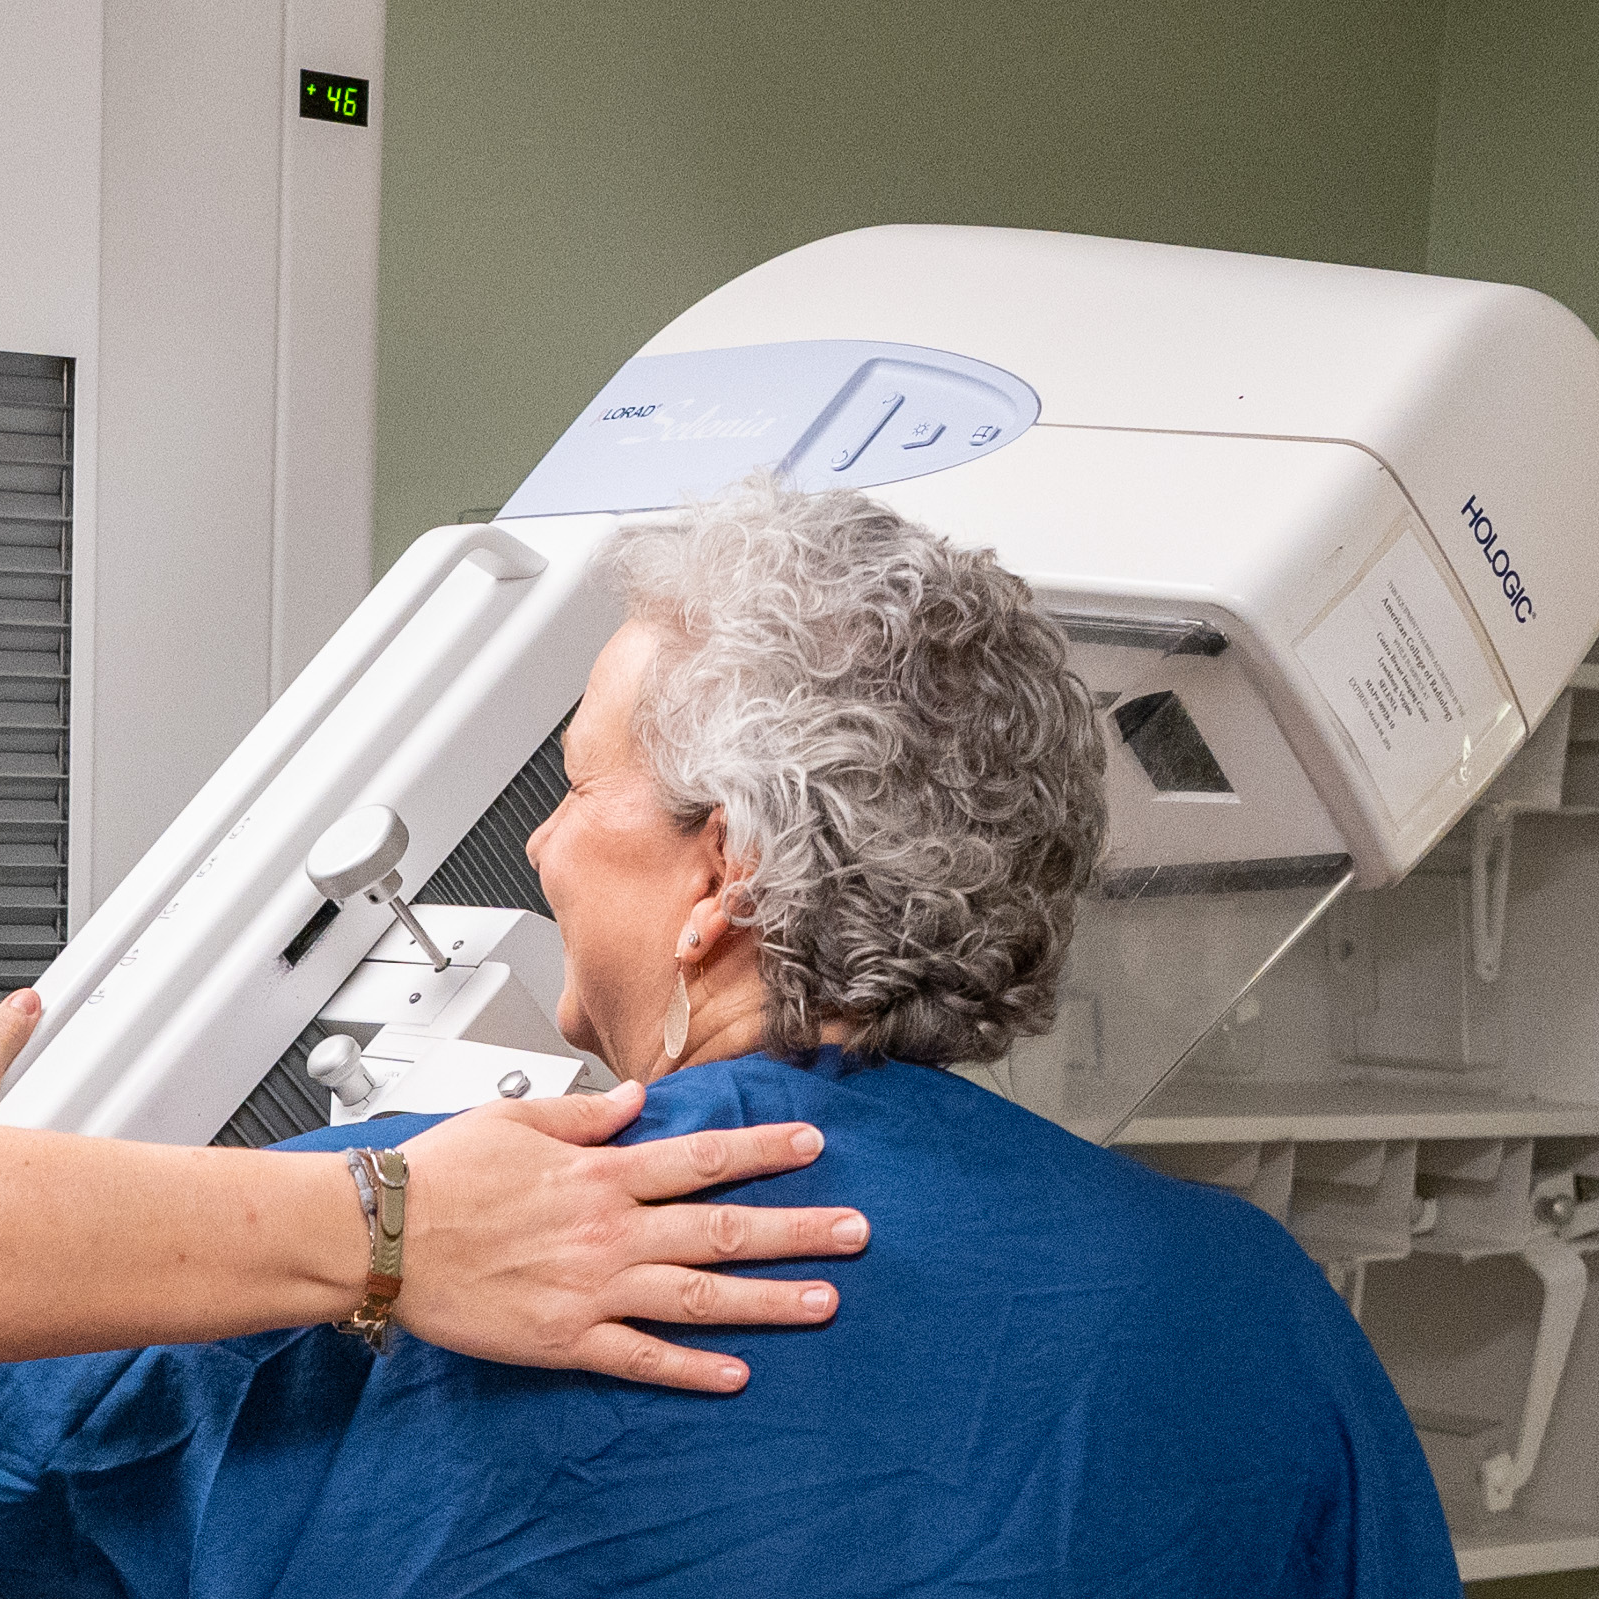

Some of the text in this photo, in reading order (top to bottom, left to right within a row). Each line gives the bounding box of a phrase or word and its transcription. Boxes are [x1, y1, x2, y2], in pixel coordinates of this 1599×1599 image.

[327, 85, 358, 117] 46
[601, 404, 657, 421] LORAD
[1461, 494, 1533, 624] HOLOGIC
[1376, 632, 1430, 722] Centra Breast Imaging Center
[1382, 596, 1454, 722] American College of Radiology
[1378, 679, 1398, 710] SELENIA
